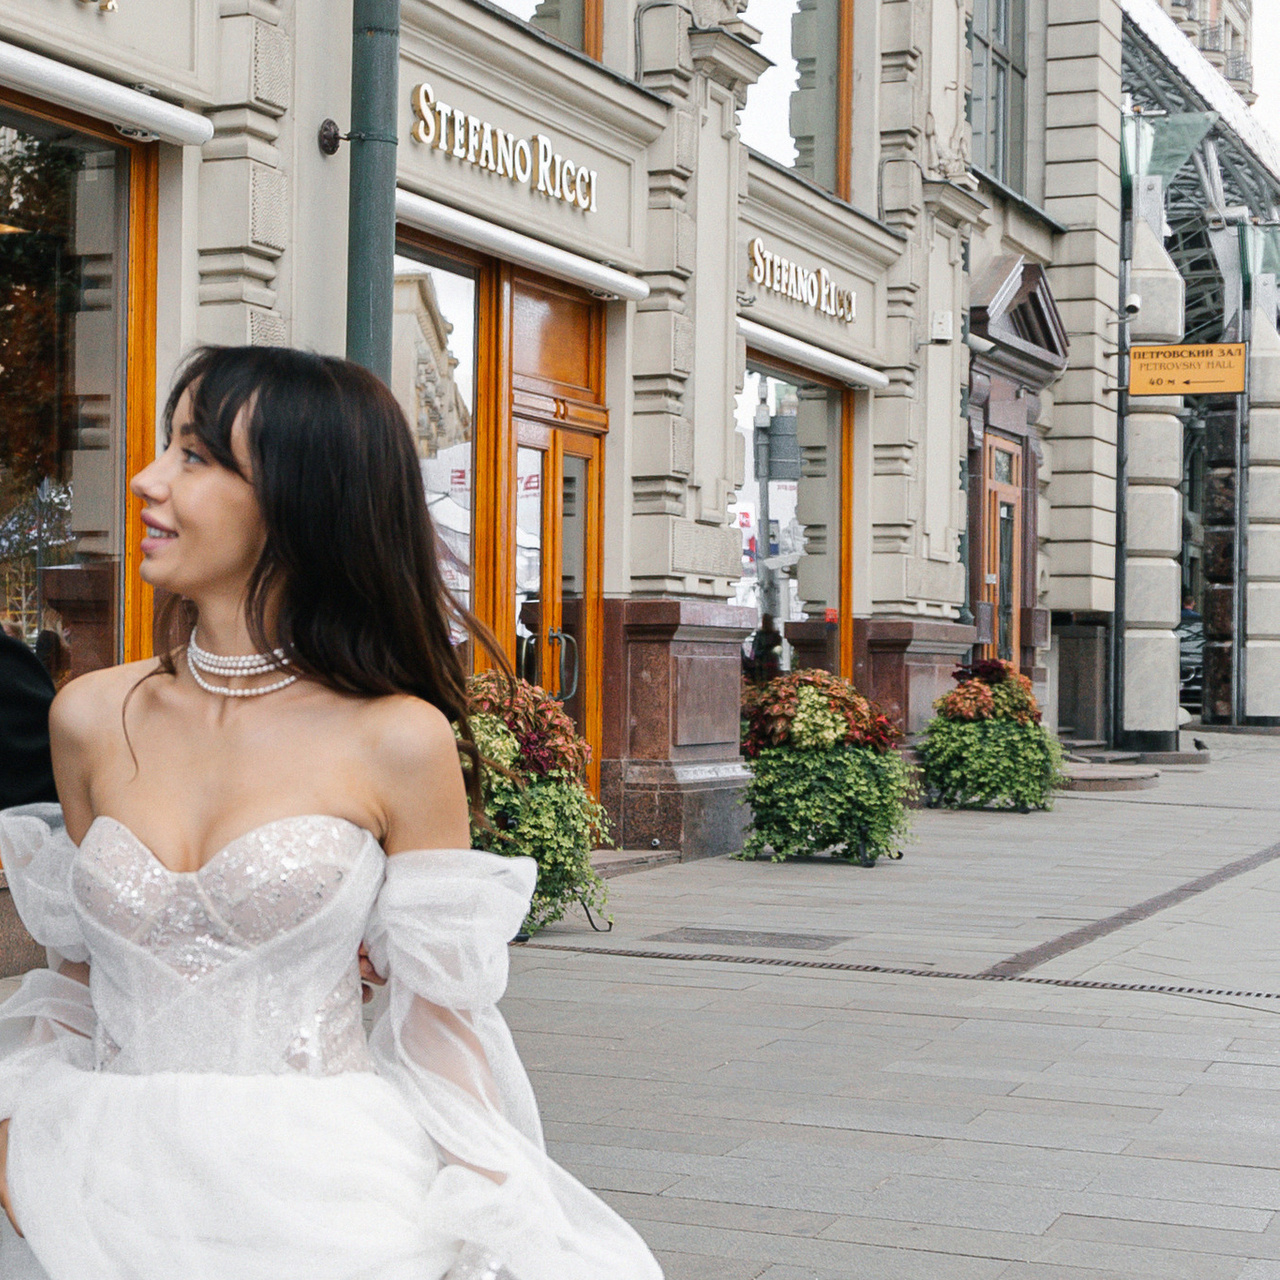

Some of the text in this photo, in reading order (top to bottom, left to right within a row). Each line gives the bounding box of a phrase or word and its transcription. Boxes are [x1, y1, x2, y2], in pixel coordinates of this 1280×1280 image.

[411, 82, 598, 213] STEFANO RICCI
[748, 237, 818, 307] STEFANO
[1133, 347, 1242, 360] ПЕТРОВСКИЙ ЗАЛ
[1140, 360, 1235, 371] PETROVSKY HALL
[1149, 378, 1164, 386] 40
